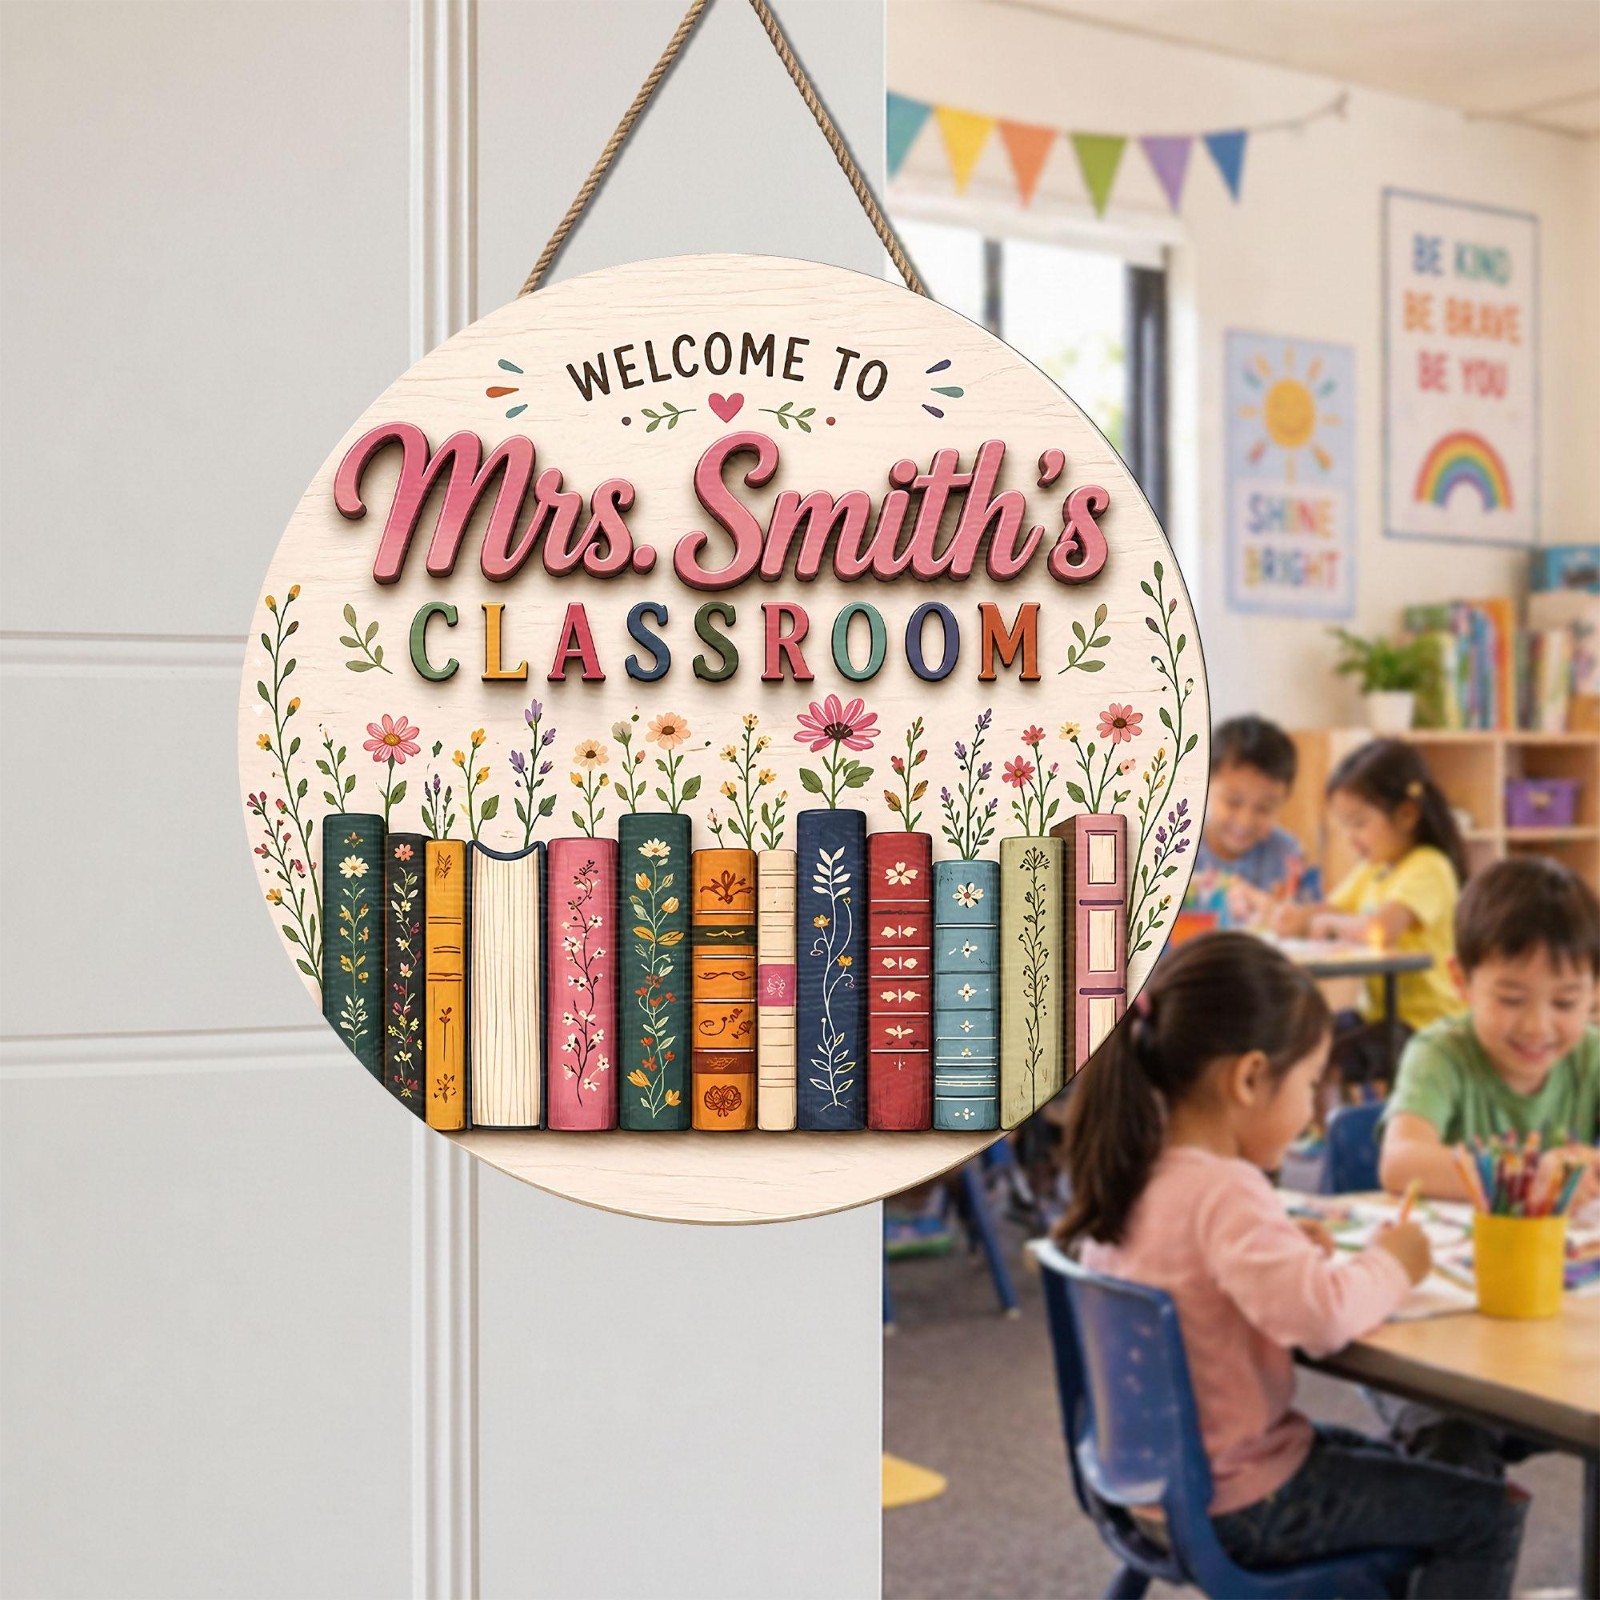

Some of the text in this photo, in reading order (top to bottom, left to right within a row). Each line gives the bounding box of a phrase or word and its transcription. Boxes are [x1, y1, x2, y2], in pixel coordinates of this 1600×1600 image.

[1413, 234, 1511, 287] BE KIND
[1404, 290, 1521, 345] BE BRAVE
[566, 331, 888, 402] WELCOME TO
[1417, 350, 1508, 400] BE YOU
[334, 421, 1110, 592] Mrs. Smith's
[1248, 492, 1333, 539] SHINE
[1243, 544, 1339, 590] BRIGHT
[408, 601, 1042, 683] CLASSROOM
